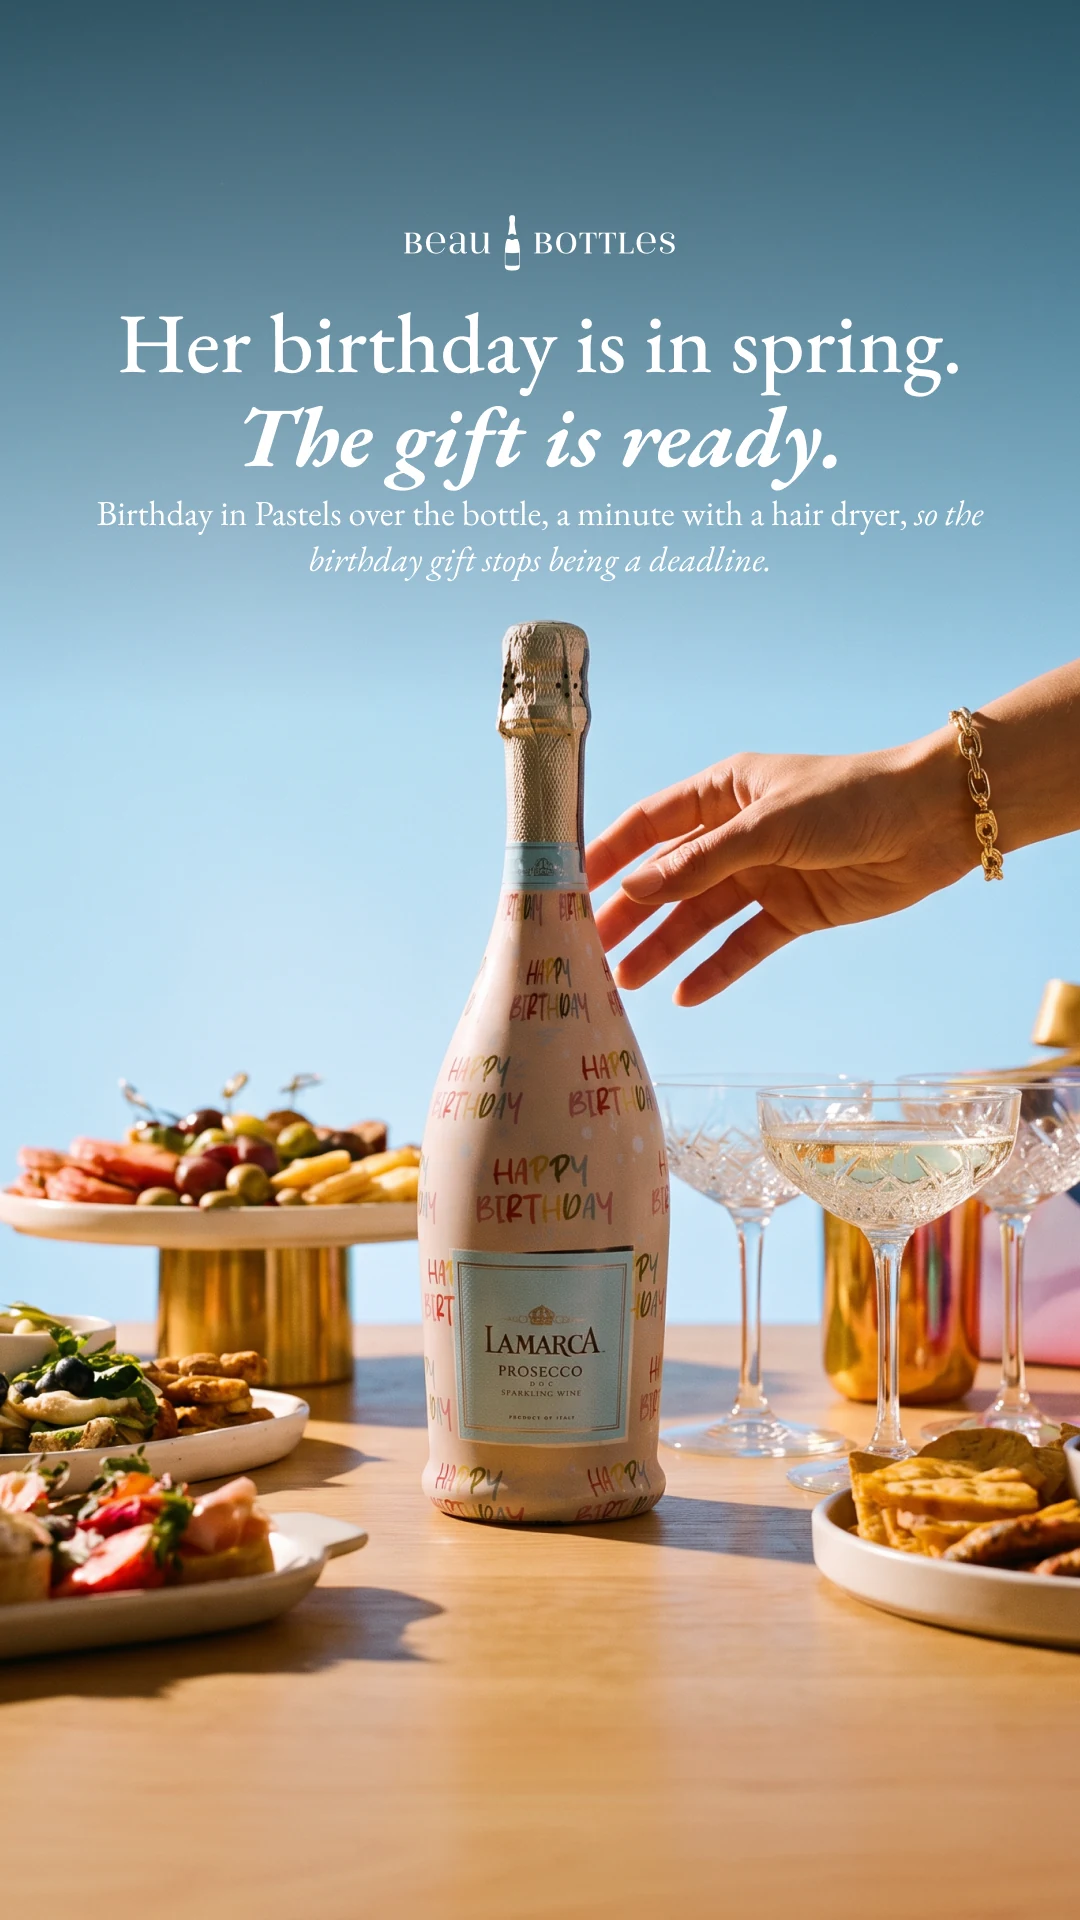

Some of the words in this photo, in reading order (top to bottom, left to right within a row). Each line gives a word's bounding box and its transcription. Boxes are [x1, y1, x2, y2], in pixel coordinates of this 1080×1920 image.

[526, 957, 572, 987] HAPPY
[509, 993, 590, 1023] BIRTHDAY
[448, 1055, 511, 1088] HAPPY
[581, 1050, 643, 1081] HAPPY
[431, 1091, 524, 1125] BIRTHDAY
[568, 1085, 656, 1118] BIRTHDA
[493, 1154, 589, 1187] HAPPY
[475, 1191, 614, 1225] BIRTHDAY
[498, 1365, 583, 1378] PROSECCO
[501, 1389, 553, 1397] SPARKLING
[434, 1462, 503, 1501] HAPPY
[587, 1459, 650, 1497] HAPPY
